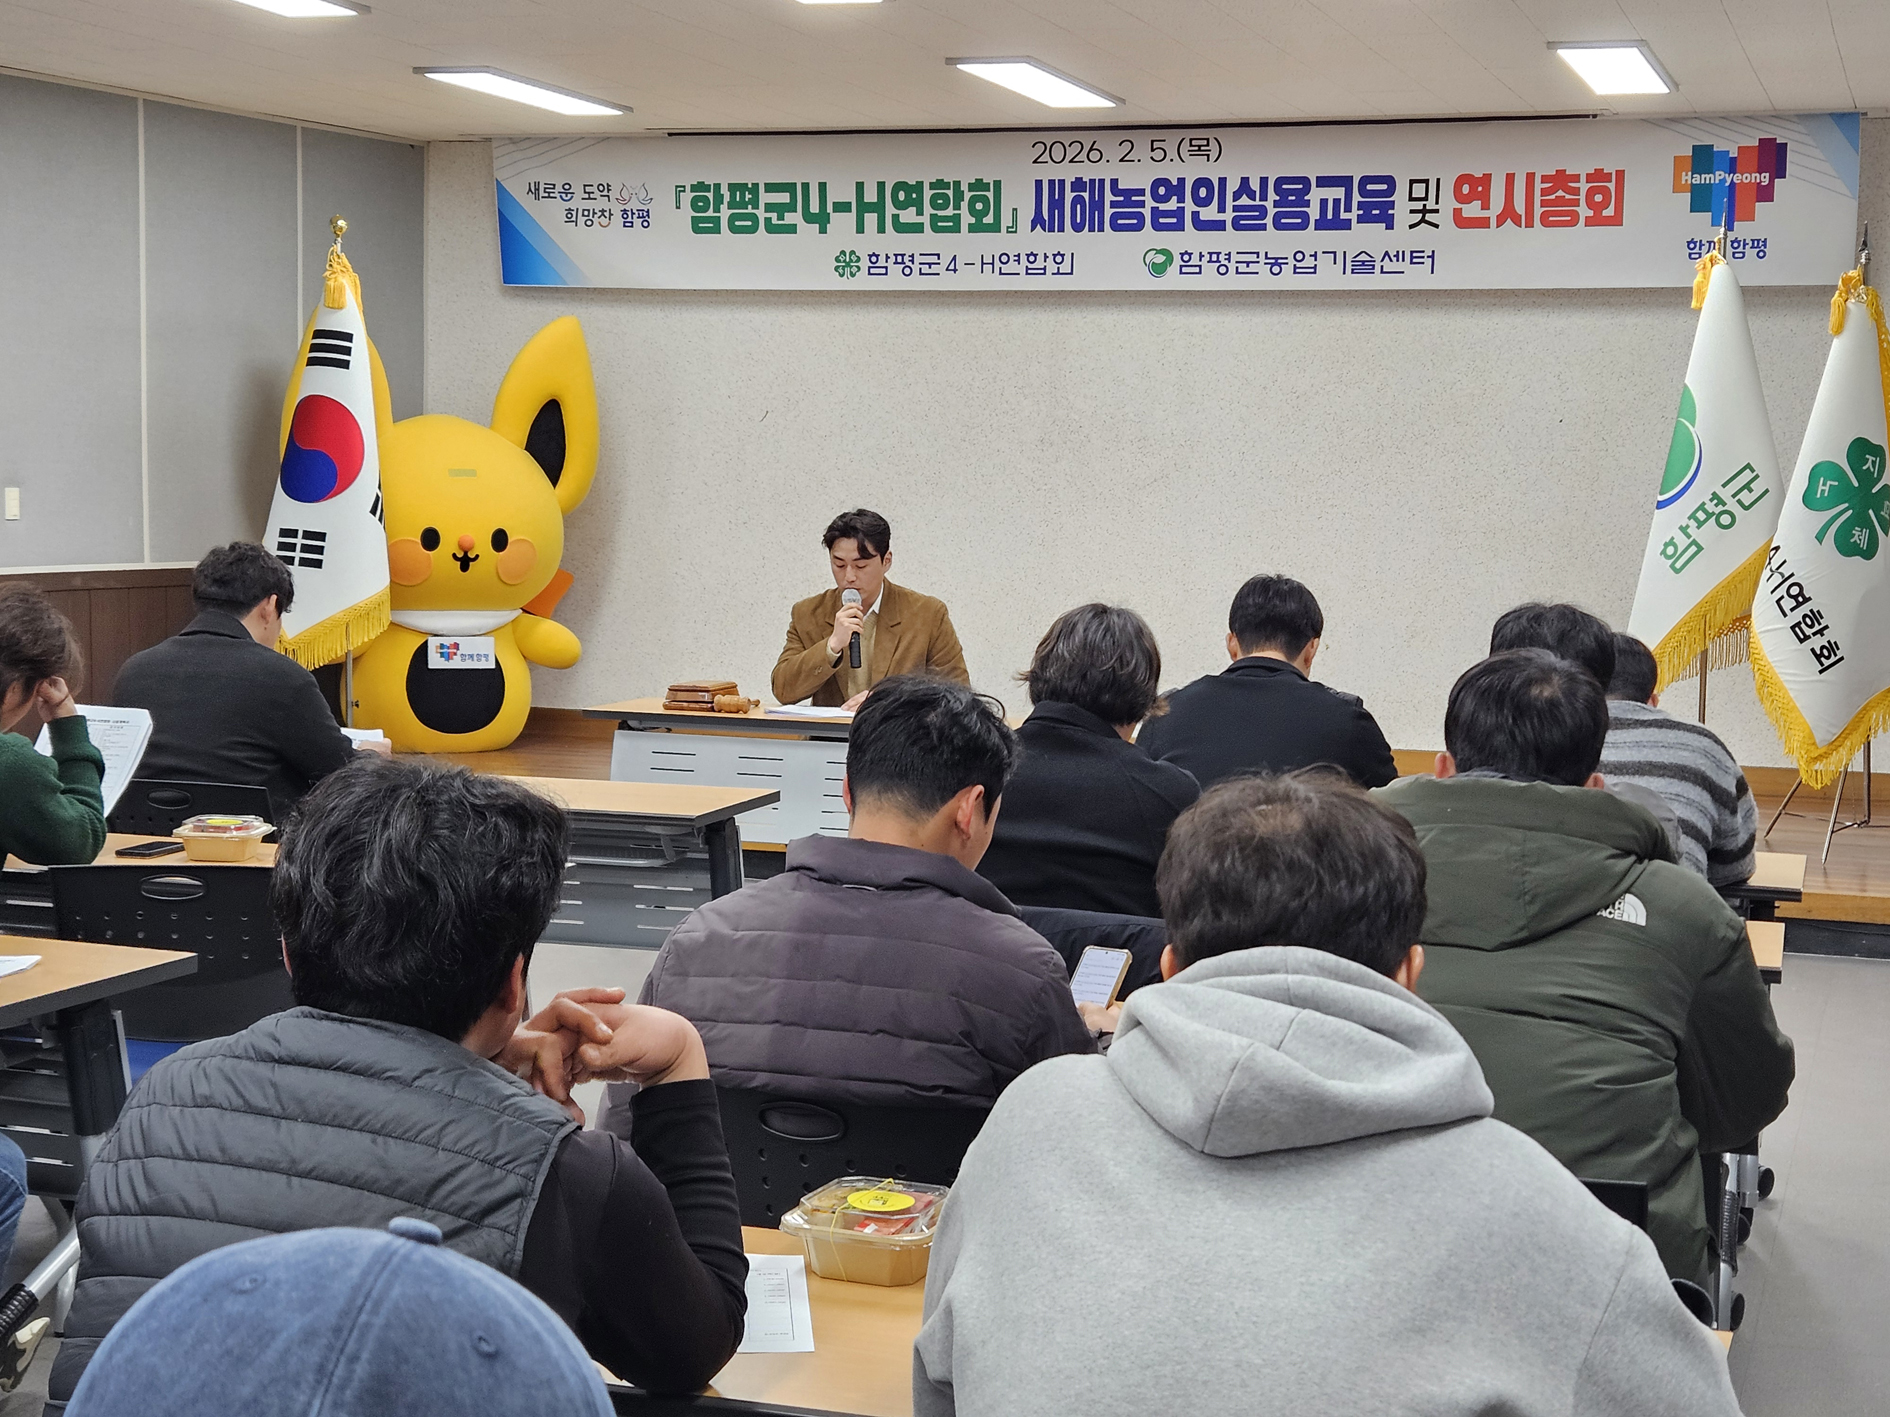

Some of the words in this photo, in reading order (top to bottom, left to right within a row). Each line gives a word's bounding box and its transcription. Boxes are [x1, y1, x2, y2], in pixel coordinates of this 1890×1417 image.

[1031, 140, 1111, 165] 2026.
[1681, 170, 1770, 186] HamPyeong
[526, 181, 575, 202] 새로운
[581, 182, 612, 203] 도약
[1030, 174, 1398, 234] 새해농업인실용교육
[1408, 177, 1441, 230] 및
[1452, 168, 1626, 230] 연시총회
[564, 207, 614, 228] 희망찬
[620, 208, 651, 229] 함평
[1730, 237, 1767, 259] 함평
[1178, 249, 1437, 276] 함평군농업기술센터
[1862, 454, 1880, 478] 지
[1659, 461, 1770, 575] 함평군
[1850, 526, 1869, 550] 체
[1596, 907, 1624, 921] ACE
